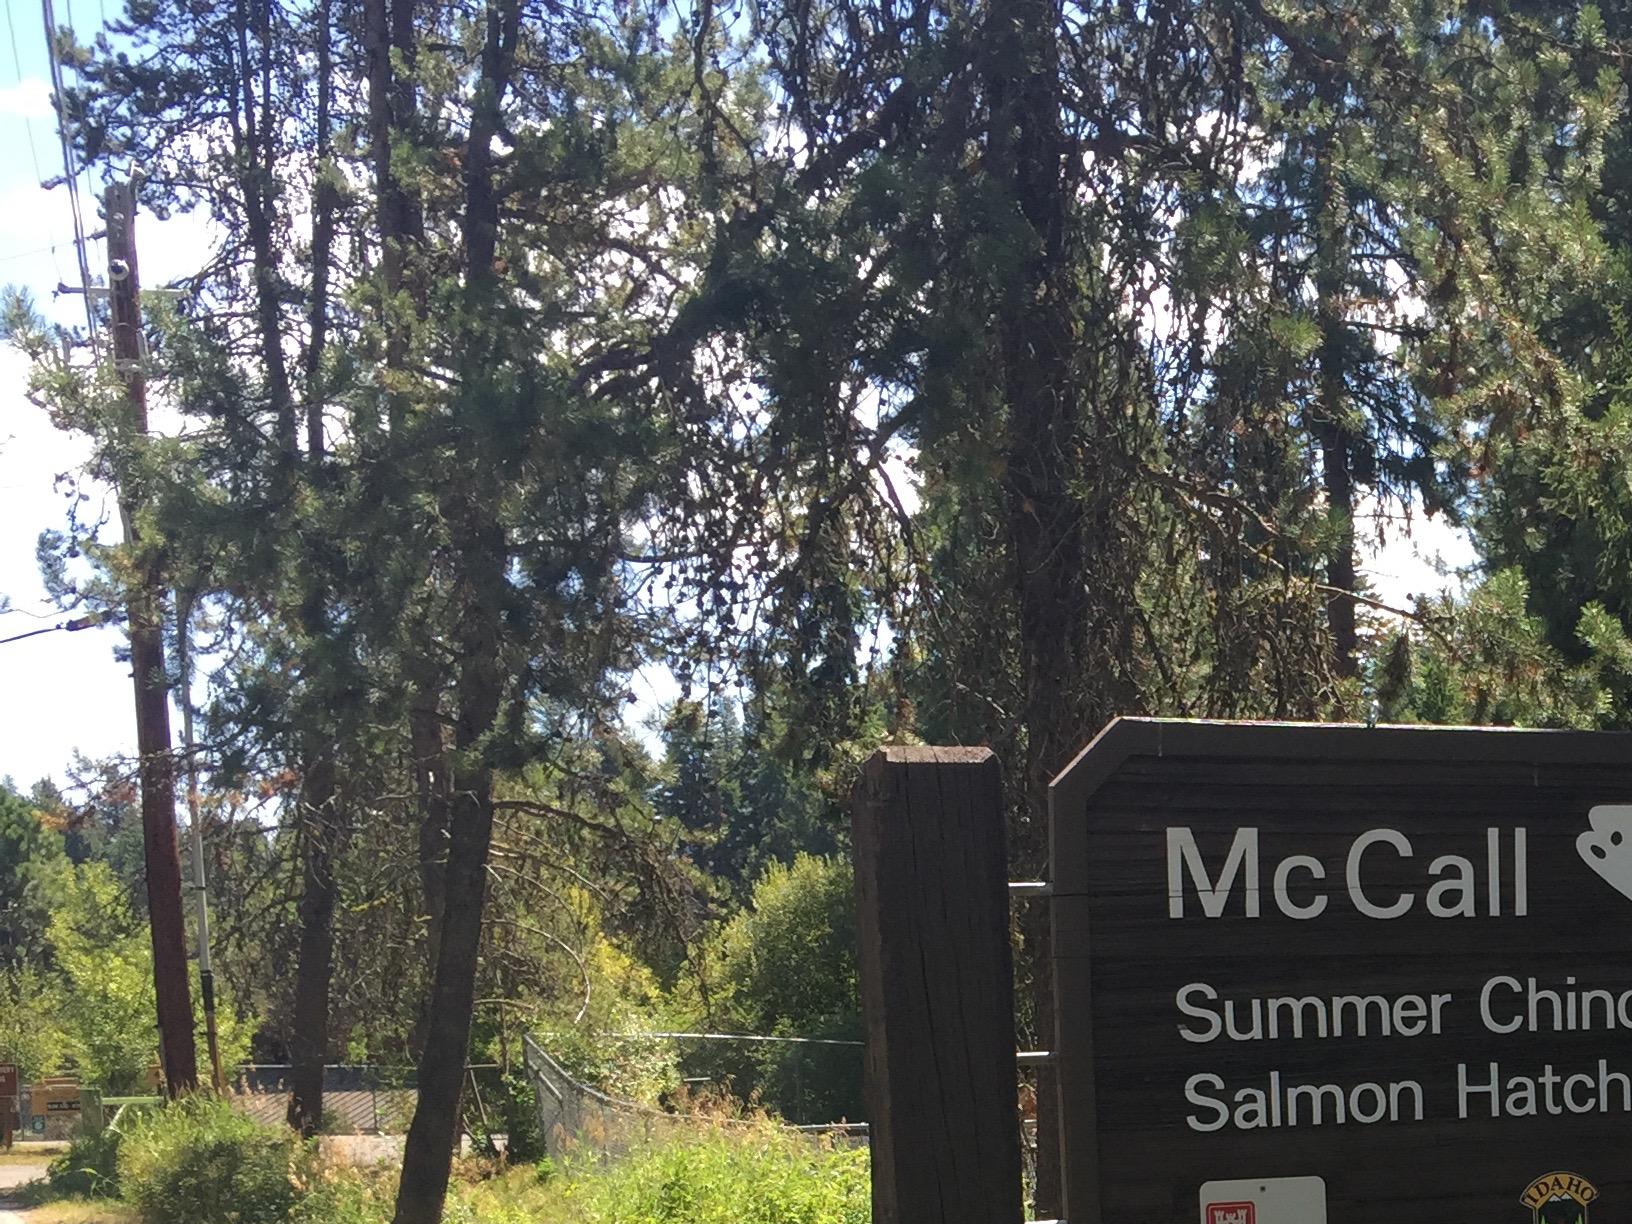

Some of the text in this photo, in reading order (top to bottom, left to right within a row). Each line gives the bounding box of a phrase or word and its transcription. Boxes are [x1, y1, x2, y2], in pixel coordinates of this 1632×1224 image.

[1166, 827, 1528, 919] McCall
[1175, 983, 1452, 1043] Summer
[1184, 1070, 1424, 1132] Salmon
[1522, 1176, 1595, 1205] IDAHO
